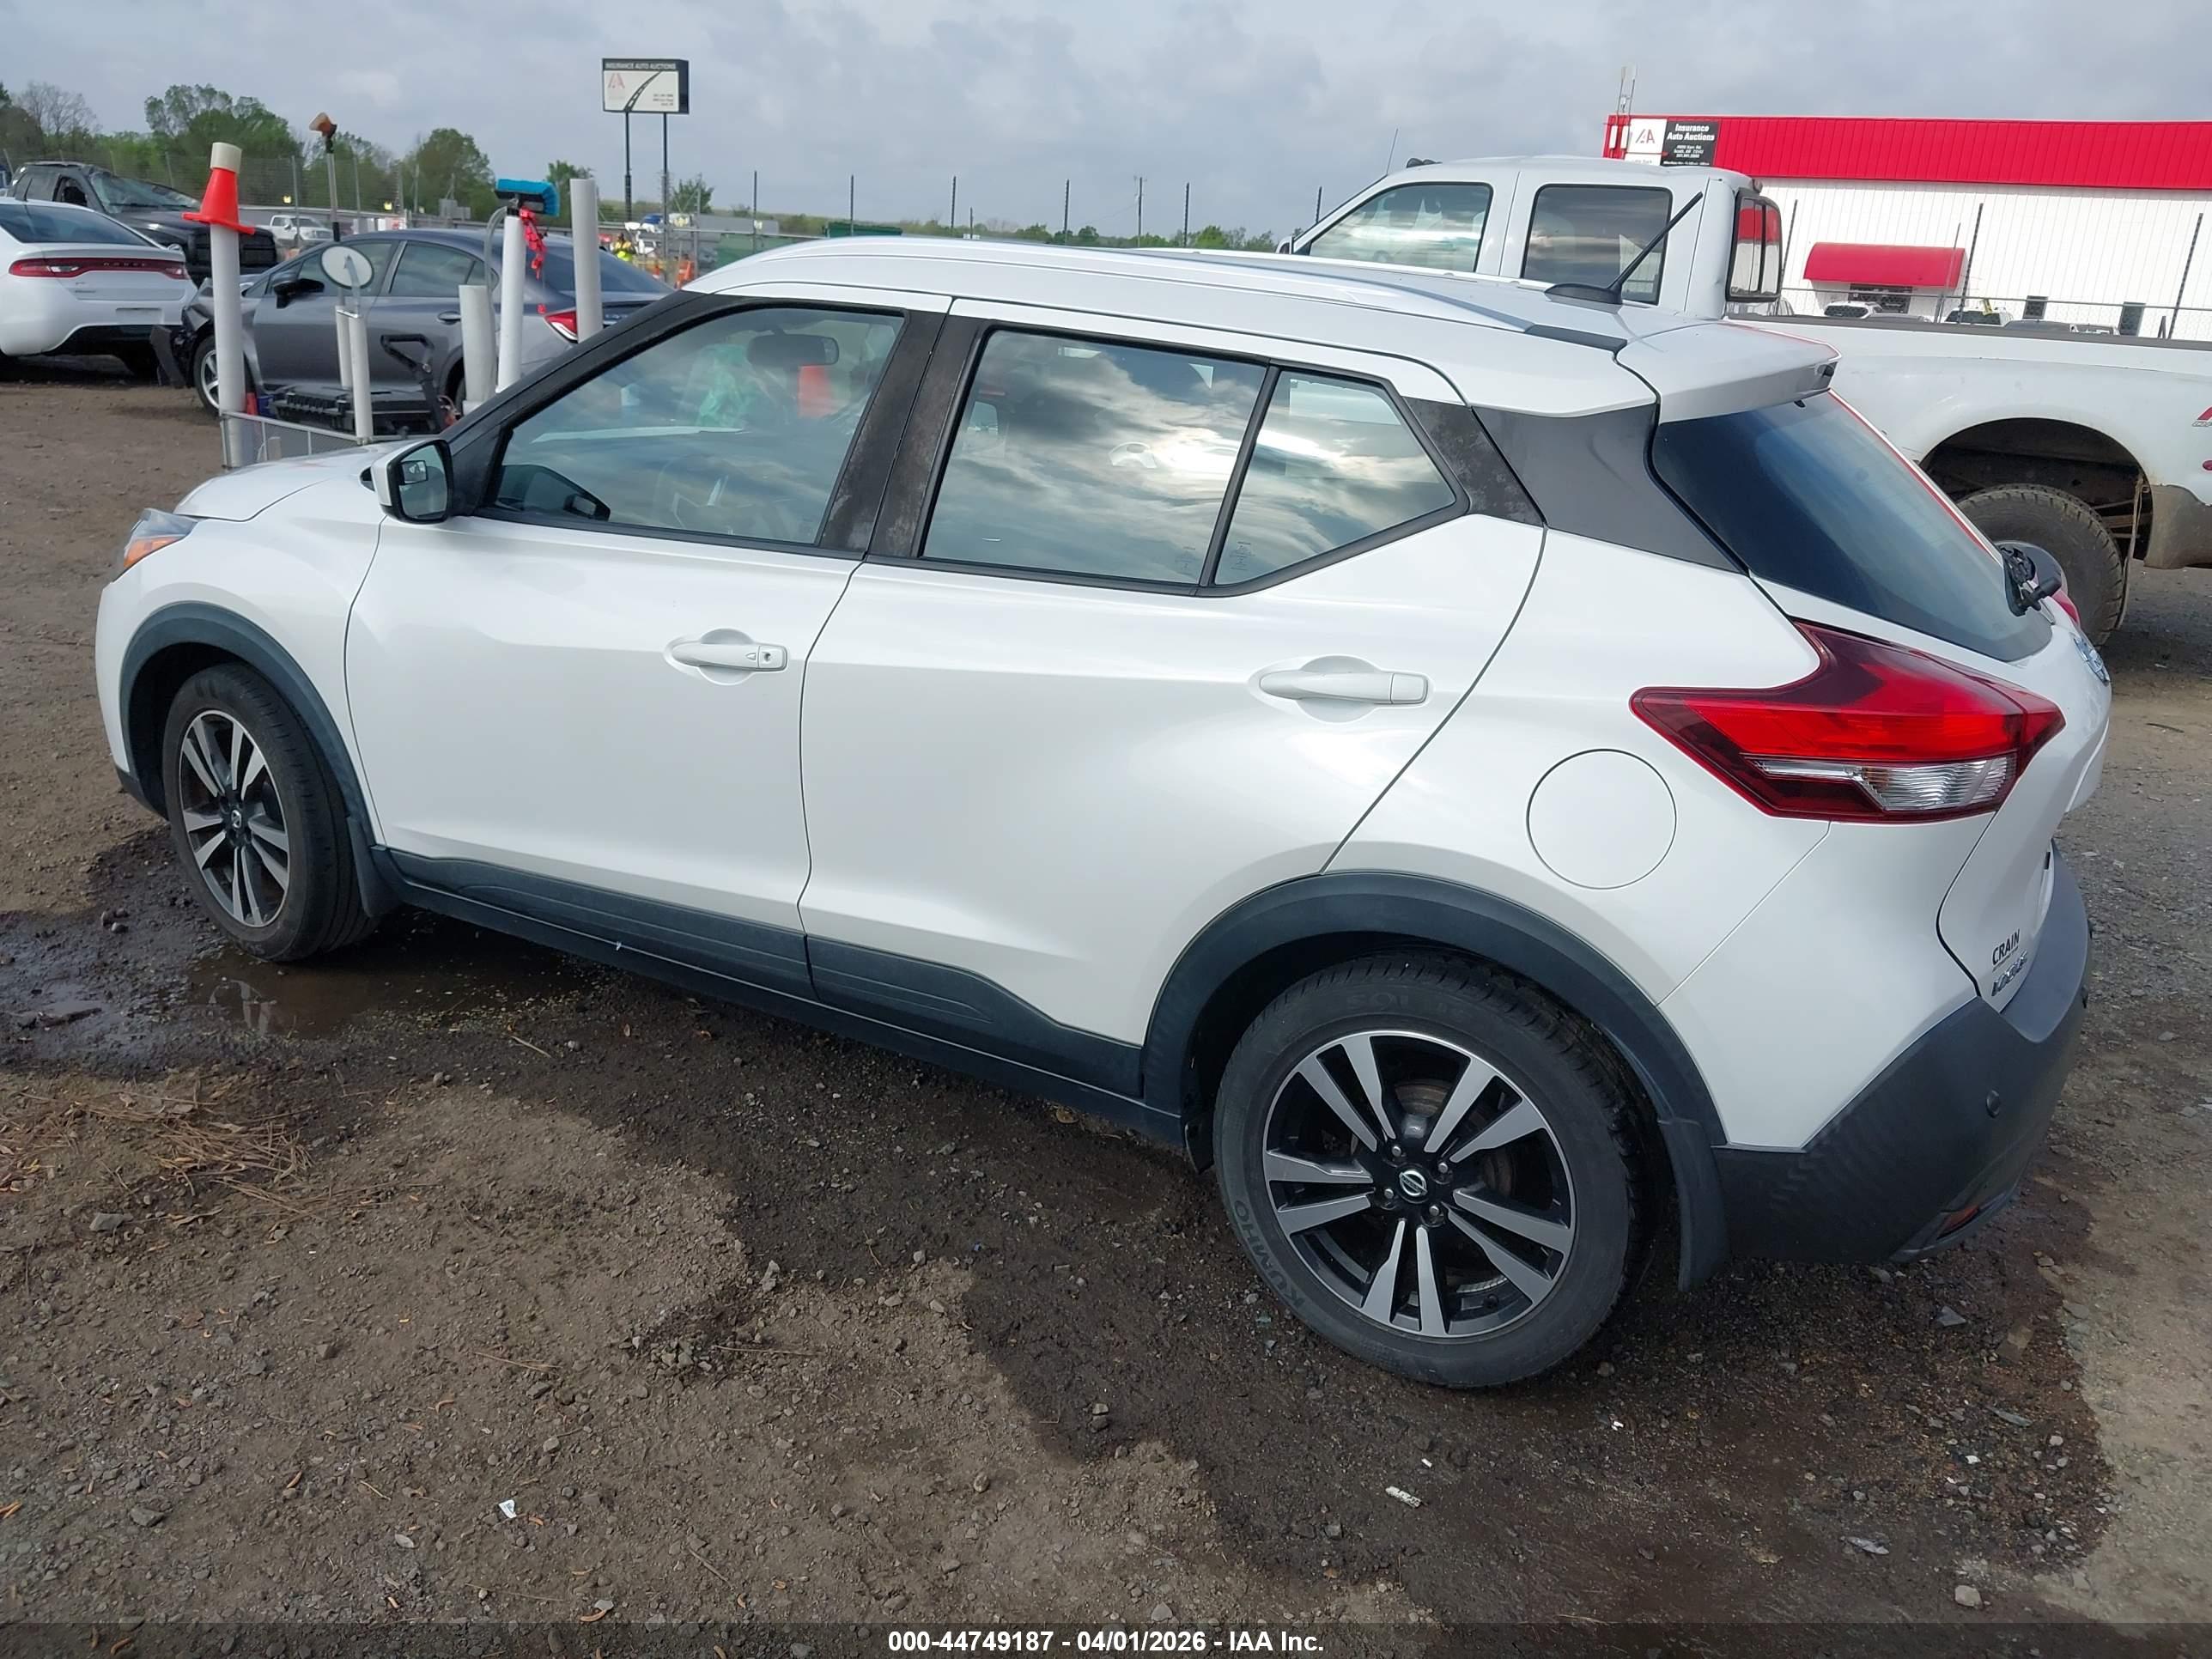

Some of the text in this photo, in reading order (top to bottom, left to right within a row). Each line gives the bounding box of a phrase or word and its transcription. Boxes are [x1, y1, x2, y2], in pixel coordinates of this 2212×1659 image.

[1675, 123, 1709, 132] Insurance
[1684, 133, 1715, 142] Auctions
[1992, 928, 2020, 965] CRAIN
[1235, 1200, 1305, 1309] KUMHO
